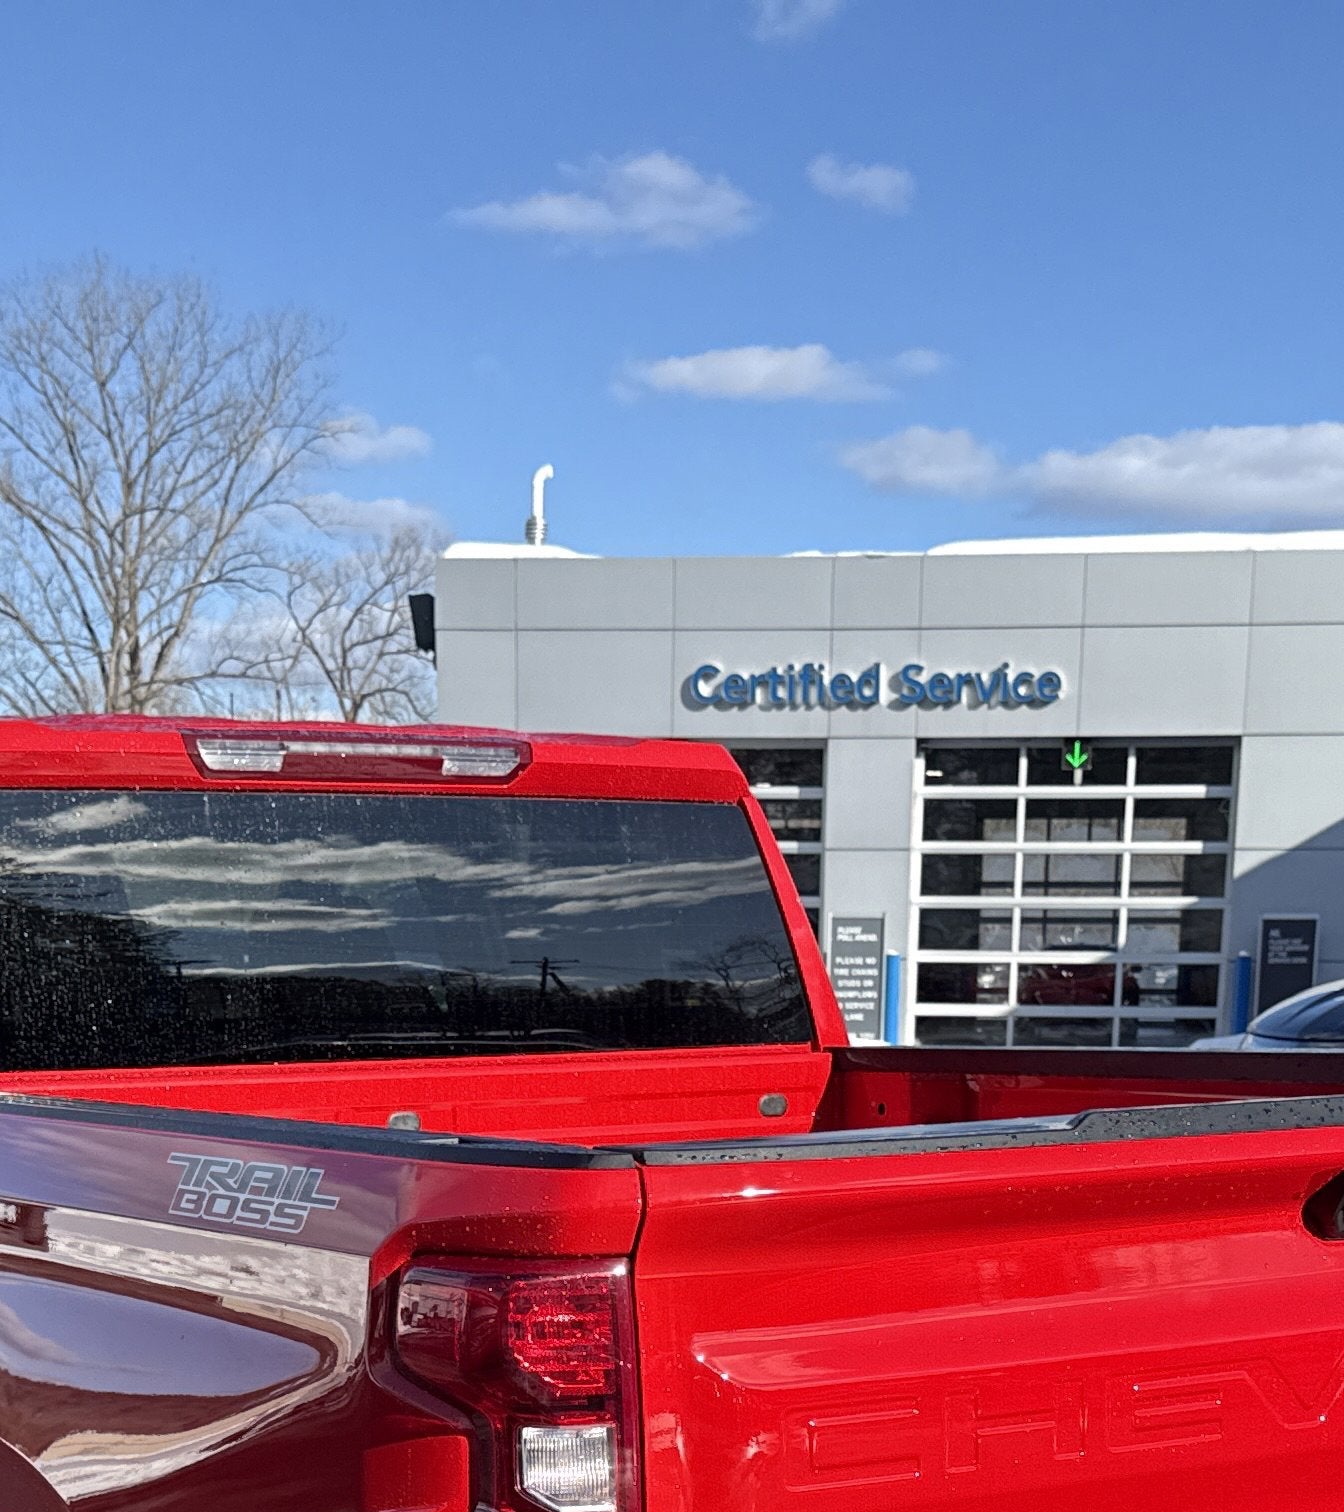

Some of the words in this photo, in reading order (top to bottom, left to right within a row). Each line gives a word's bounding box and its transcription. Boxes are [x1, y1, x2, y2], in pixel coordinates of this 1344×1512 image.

[690, 662, 881, 706] Certified
[899, 662, 1062, 706] Service
[835, 956, 864, 965] PLEASE
[864, 956, 877, 965] NO
[833, 967, 850, 976] TIRE
[850, 968, 879, 976] CHAINS
[837, 979, 862, 987] STUDS
[862, 979, 874, 987] OR
[844, 1002, 875, 1010] SERVICE
[167, 1152, 341, 1211] TRAIL
[168, 1186, 311, 1234] BOSS
